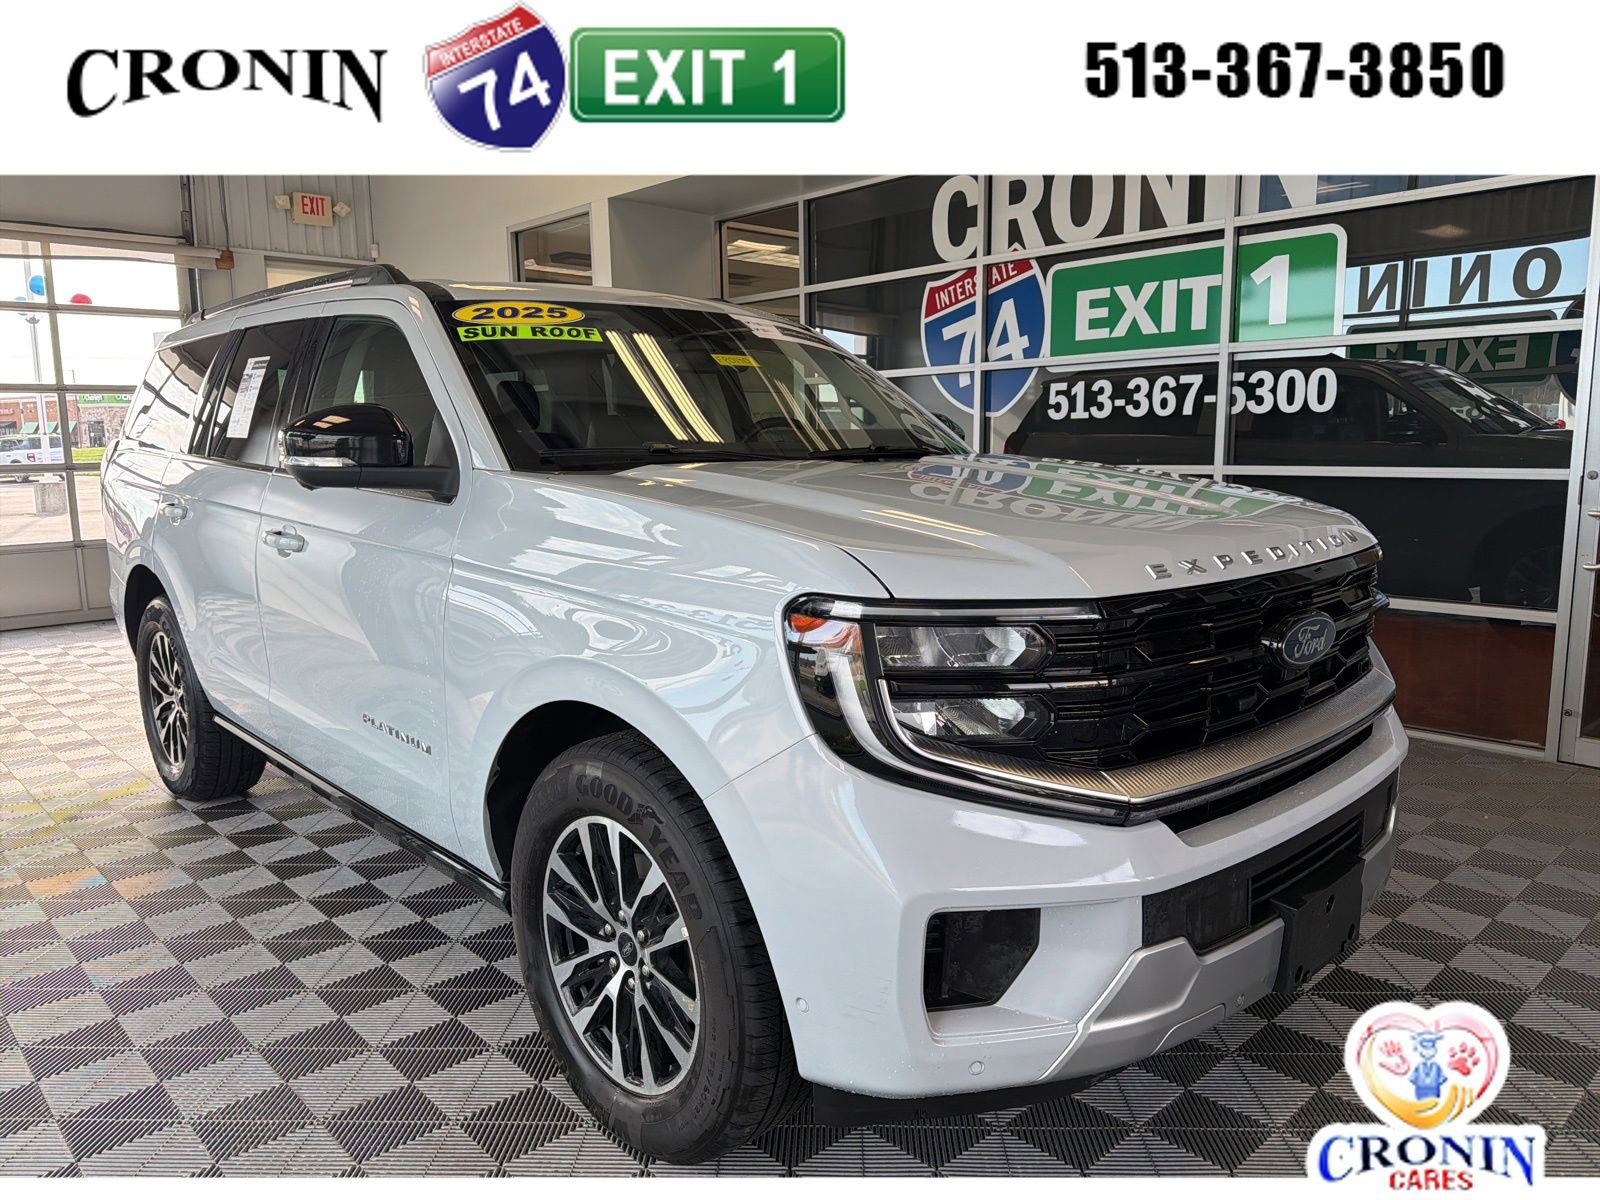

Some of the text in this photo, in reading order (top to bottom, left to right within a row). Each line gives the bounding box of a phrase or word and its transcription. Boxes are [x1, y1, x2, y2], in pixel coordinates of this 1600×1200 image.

[301, 195, 326, 217] EXIT
[935, 262, 1018, 310] INTERATE
[1075, 254, 1290, 341] EXIT 1
[463, 326, 597, 340] SUN ROOF
[471, 306, 569, 321] 2025
[942, 298, 1030, 389] 74
[1047, 367, 1338, 421] 513-367-5300
[1144, 530, 1359, 581] EXPEDITION
[1294, 623, 1329, 659] Ford
[362, 712, 432, 756] PLATINUM
[575, 774, 703, 921] GOODYEAR
